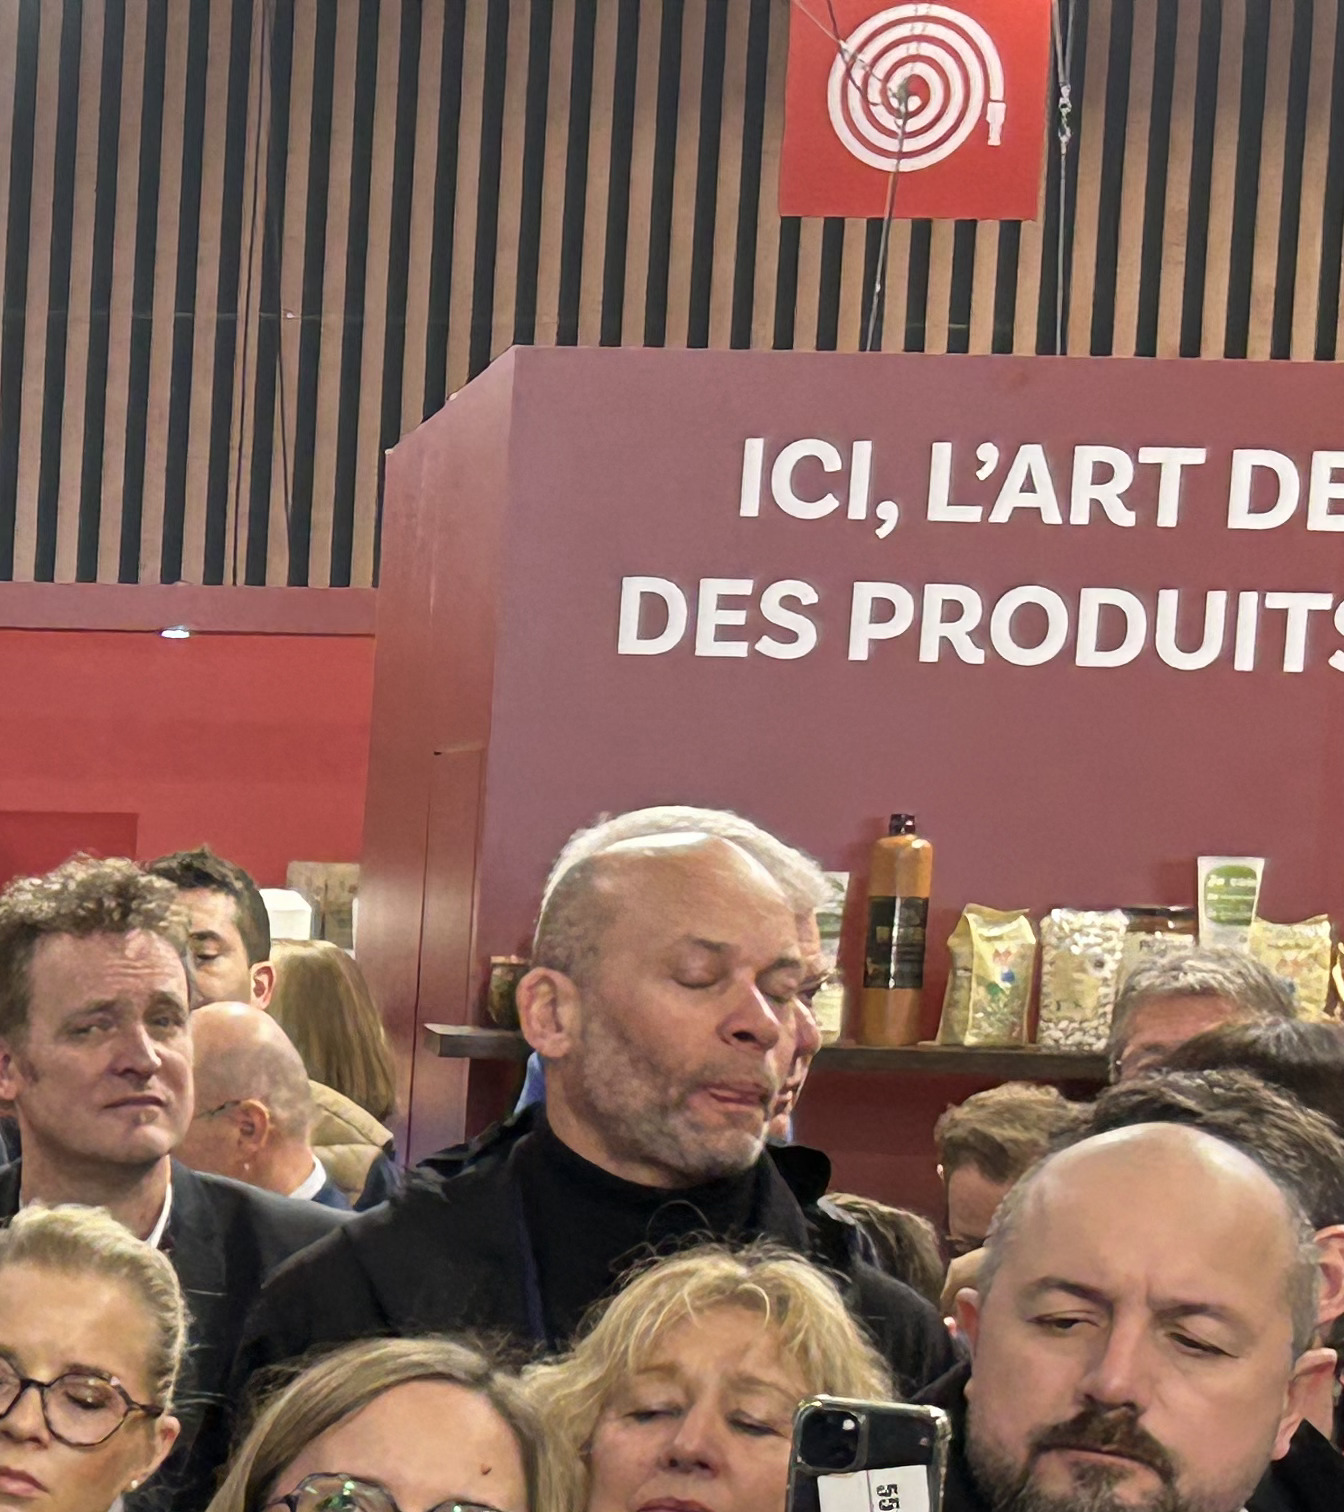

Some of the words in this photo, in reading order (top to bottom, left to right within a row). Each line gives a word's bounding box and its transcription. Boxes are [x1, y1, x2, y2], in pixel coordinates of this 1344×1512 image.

[739, 437, 899, 539] ICI,
[927, 441, 1207, 528] L'ART
[1227, 448, 1344, 532] DE
[617, 576, 819, 660] DES
[847, 581, 1344, 674] PRODUIT
